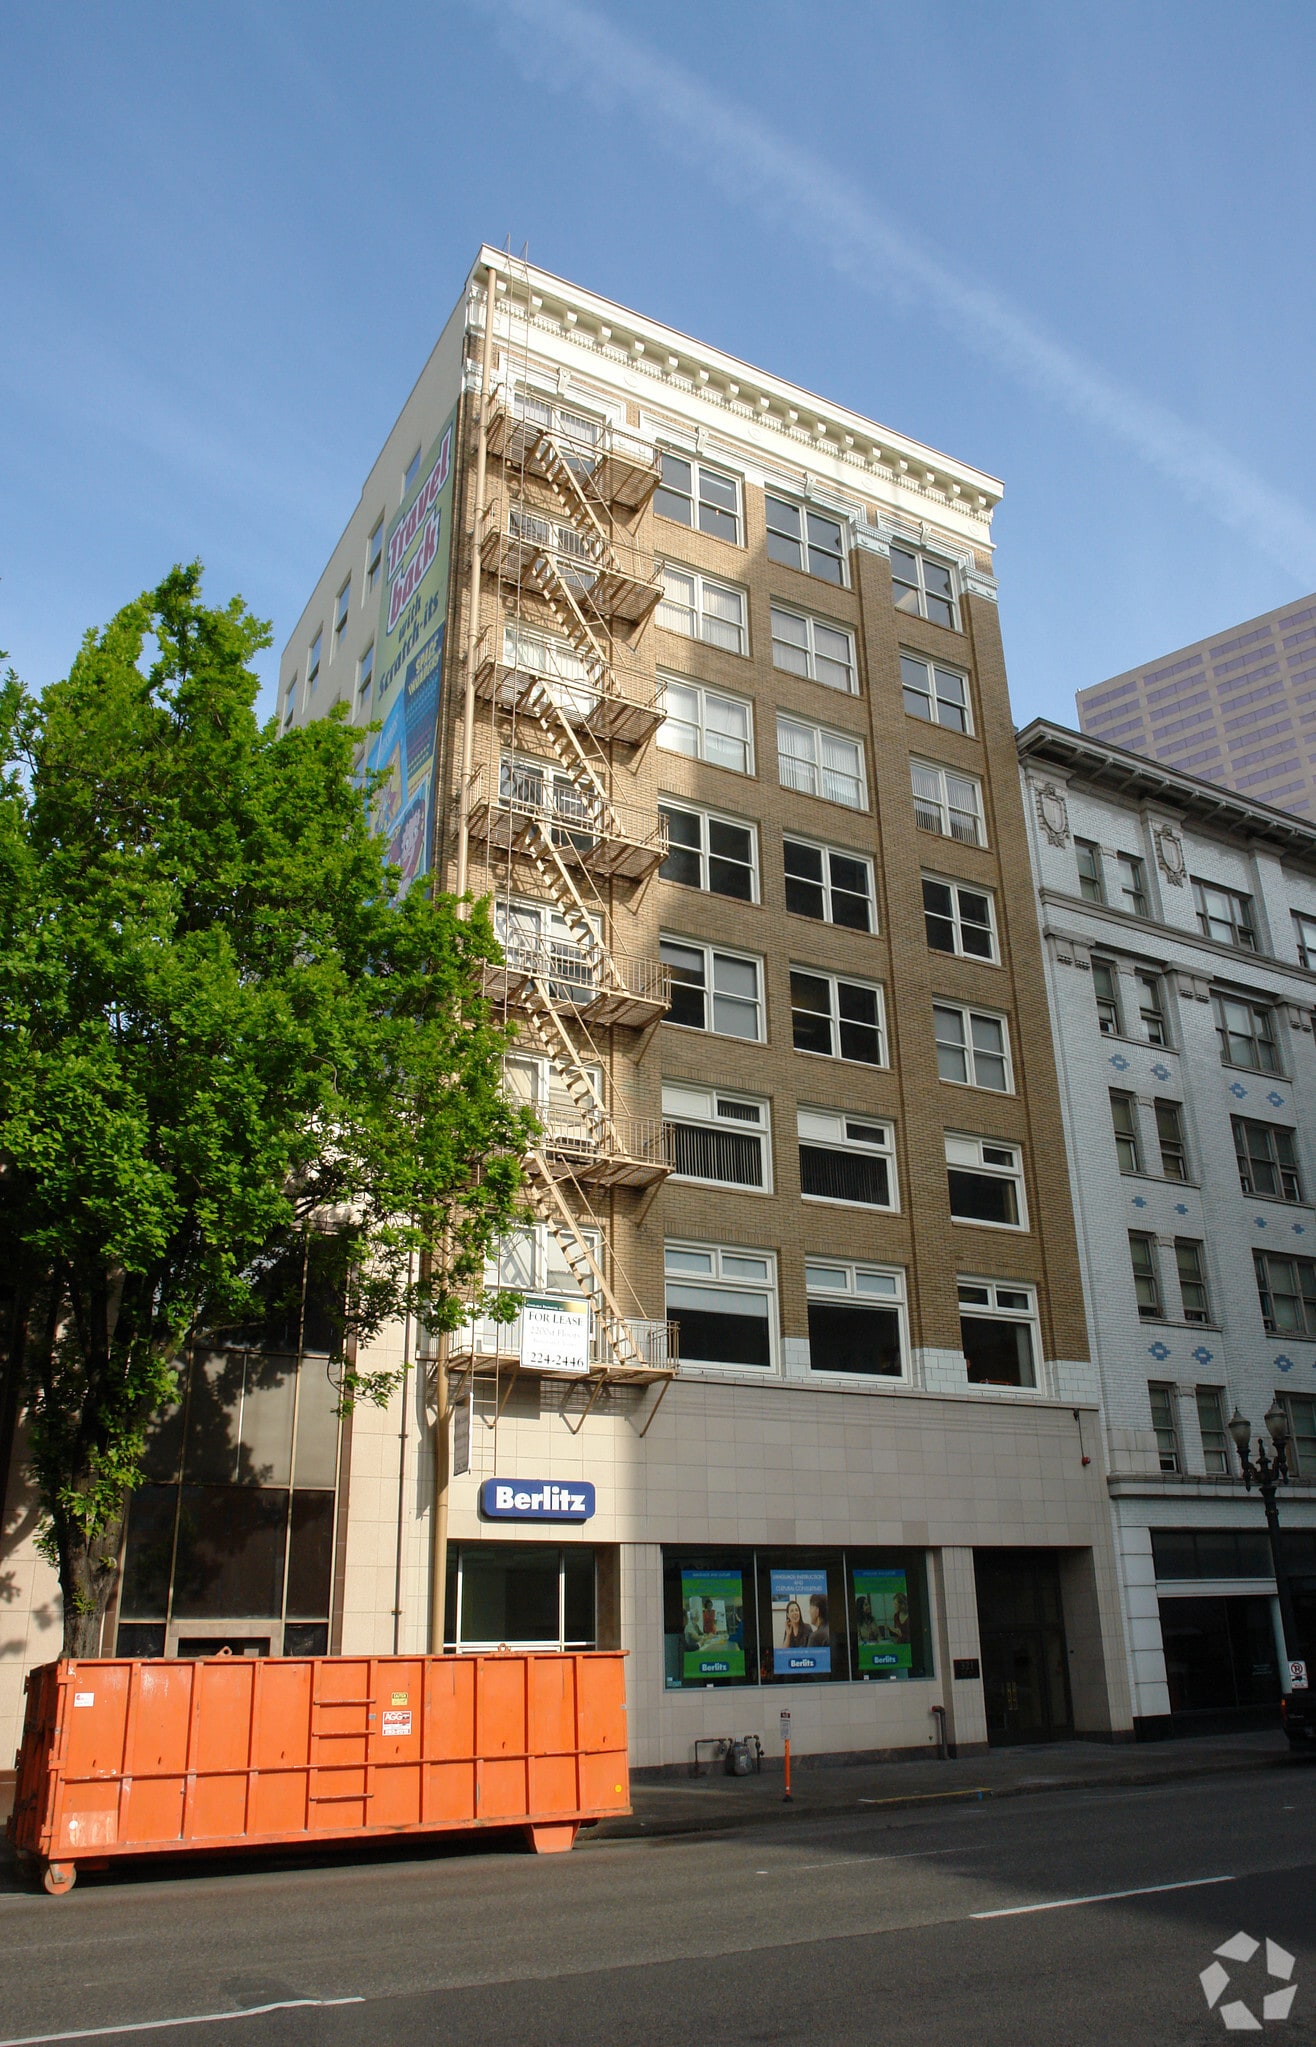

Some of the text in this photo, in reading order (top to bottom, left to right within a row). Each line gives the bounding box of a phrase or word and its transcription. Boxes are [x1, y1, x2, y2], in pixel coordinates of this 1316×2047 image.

[388, 424, 452, 581] Travel
[387, 511, 441, 633] back
[398, 594, 421, 643] with
[378, 591, 439, 701] Scratch-its
[415, 634, 439, 675] SPACE
[529, 1311, 583, 1326] FOR LEASE
[530, 1351, 584, 1367] 224-2446
[496, 1486, 586, 1511] Berlitz
[701, 1662, 727, 1672] Berlitz
[790, 1659, 815, 1668] Berlitz
[873, 1655, 896, 1664] Berlitz
